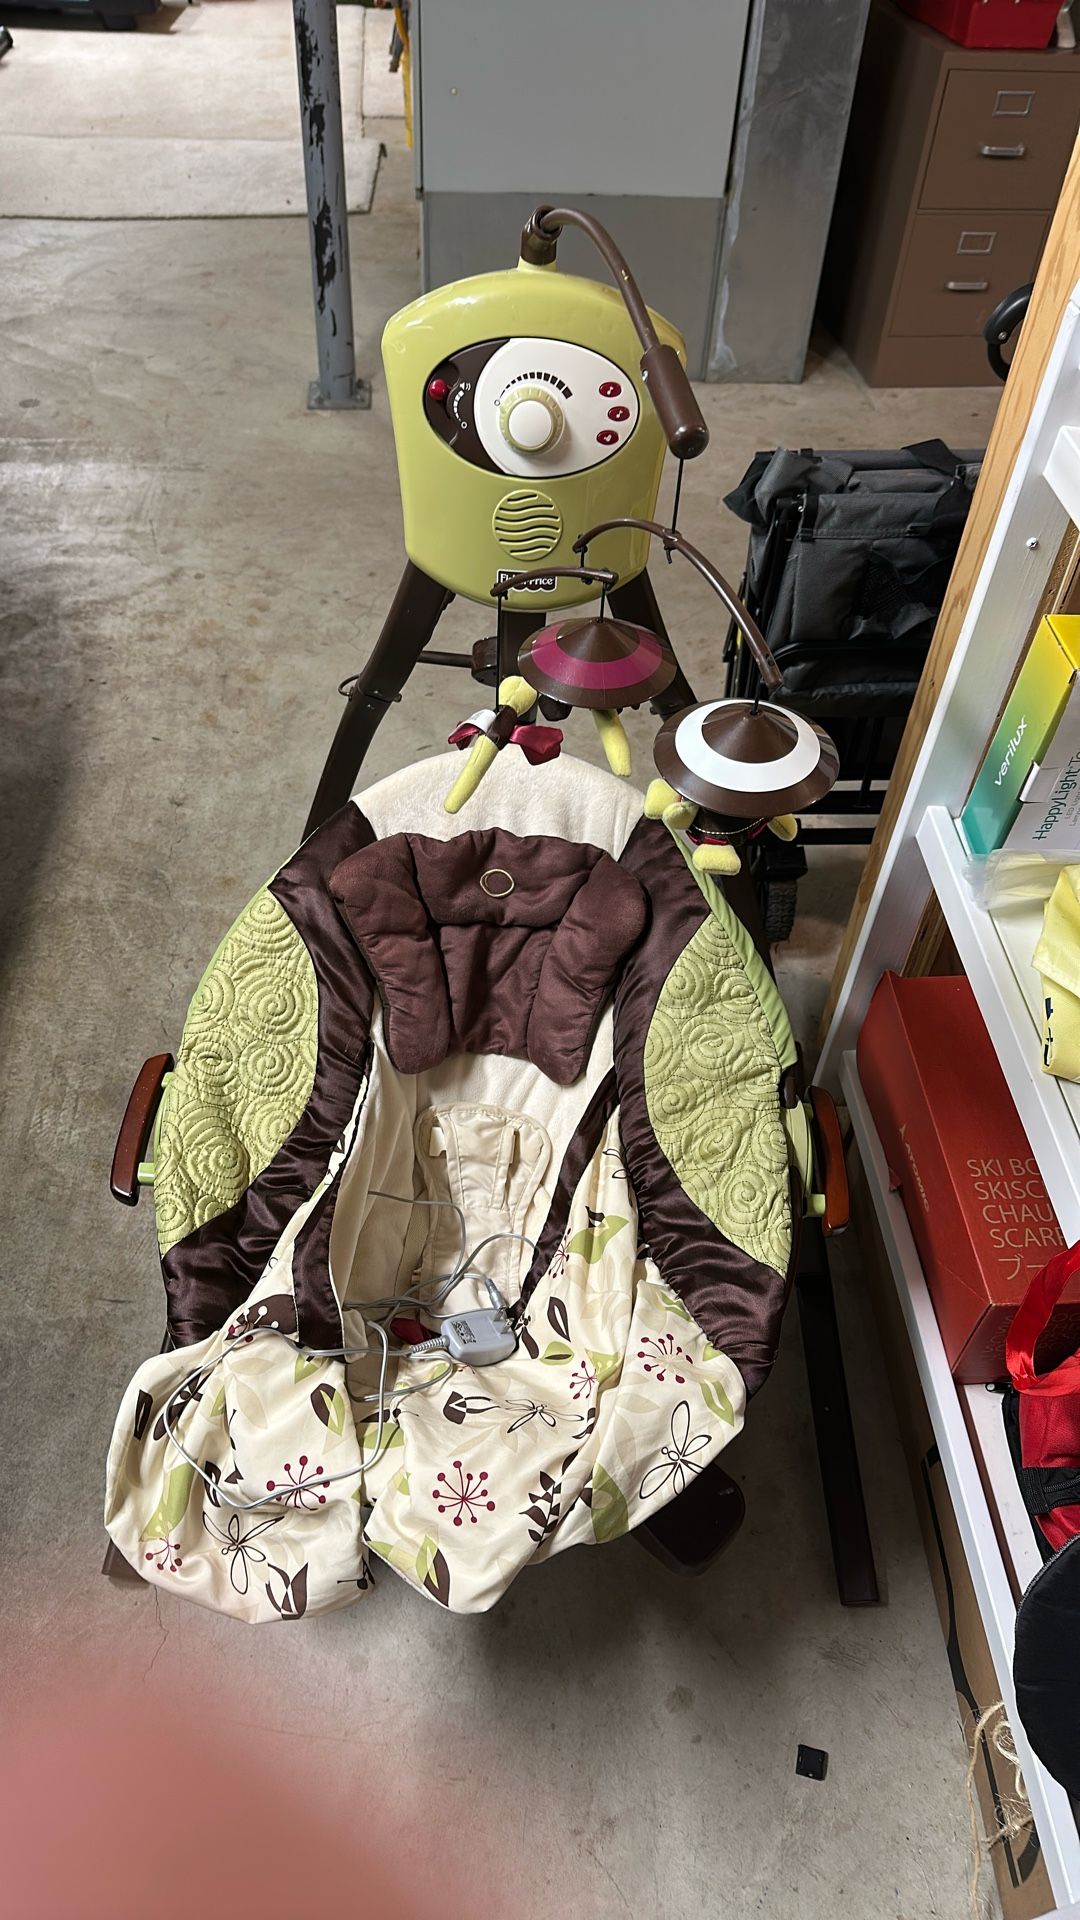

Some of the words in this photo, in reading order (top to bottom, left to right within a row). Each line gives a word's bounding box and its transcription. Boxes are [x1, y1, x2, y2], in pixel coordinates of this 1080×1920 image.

[994, 714, 1028, 786] verilux
[1032, 766, 1080, 841] HappyLight
[966, 1159, 1004, 1178] SKI
[982, 1203, 1054, 1224] CHAU
